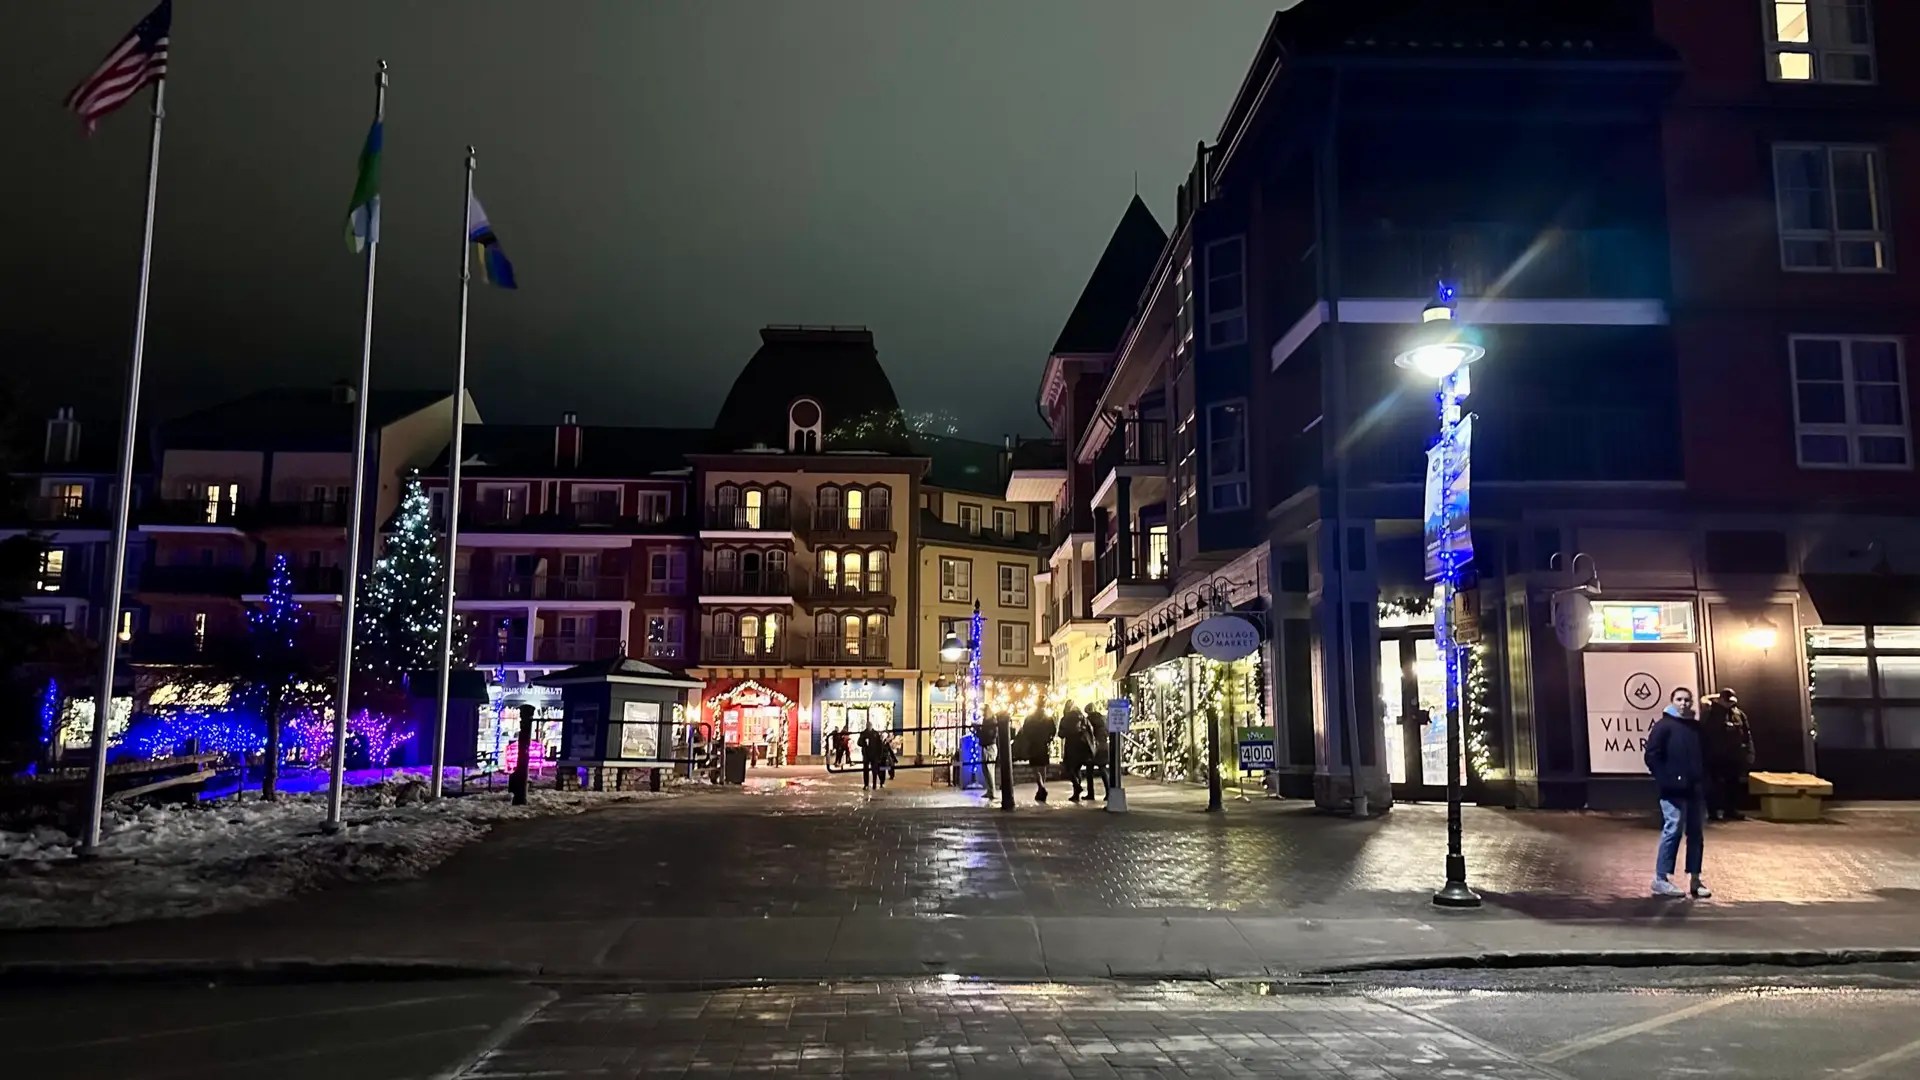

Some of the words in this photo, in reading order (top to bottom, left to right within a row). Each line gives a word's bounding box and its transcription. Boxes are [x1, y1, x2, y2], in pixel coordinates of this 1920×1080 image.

[840, 686, 873, 702] Hatley
[1601, 717, 1656, 732] VILLA
[1605, 737, 1648, 752] MAR
